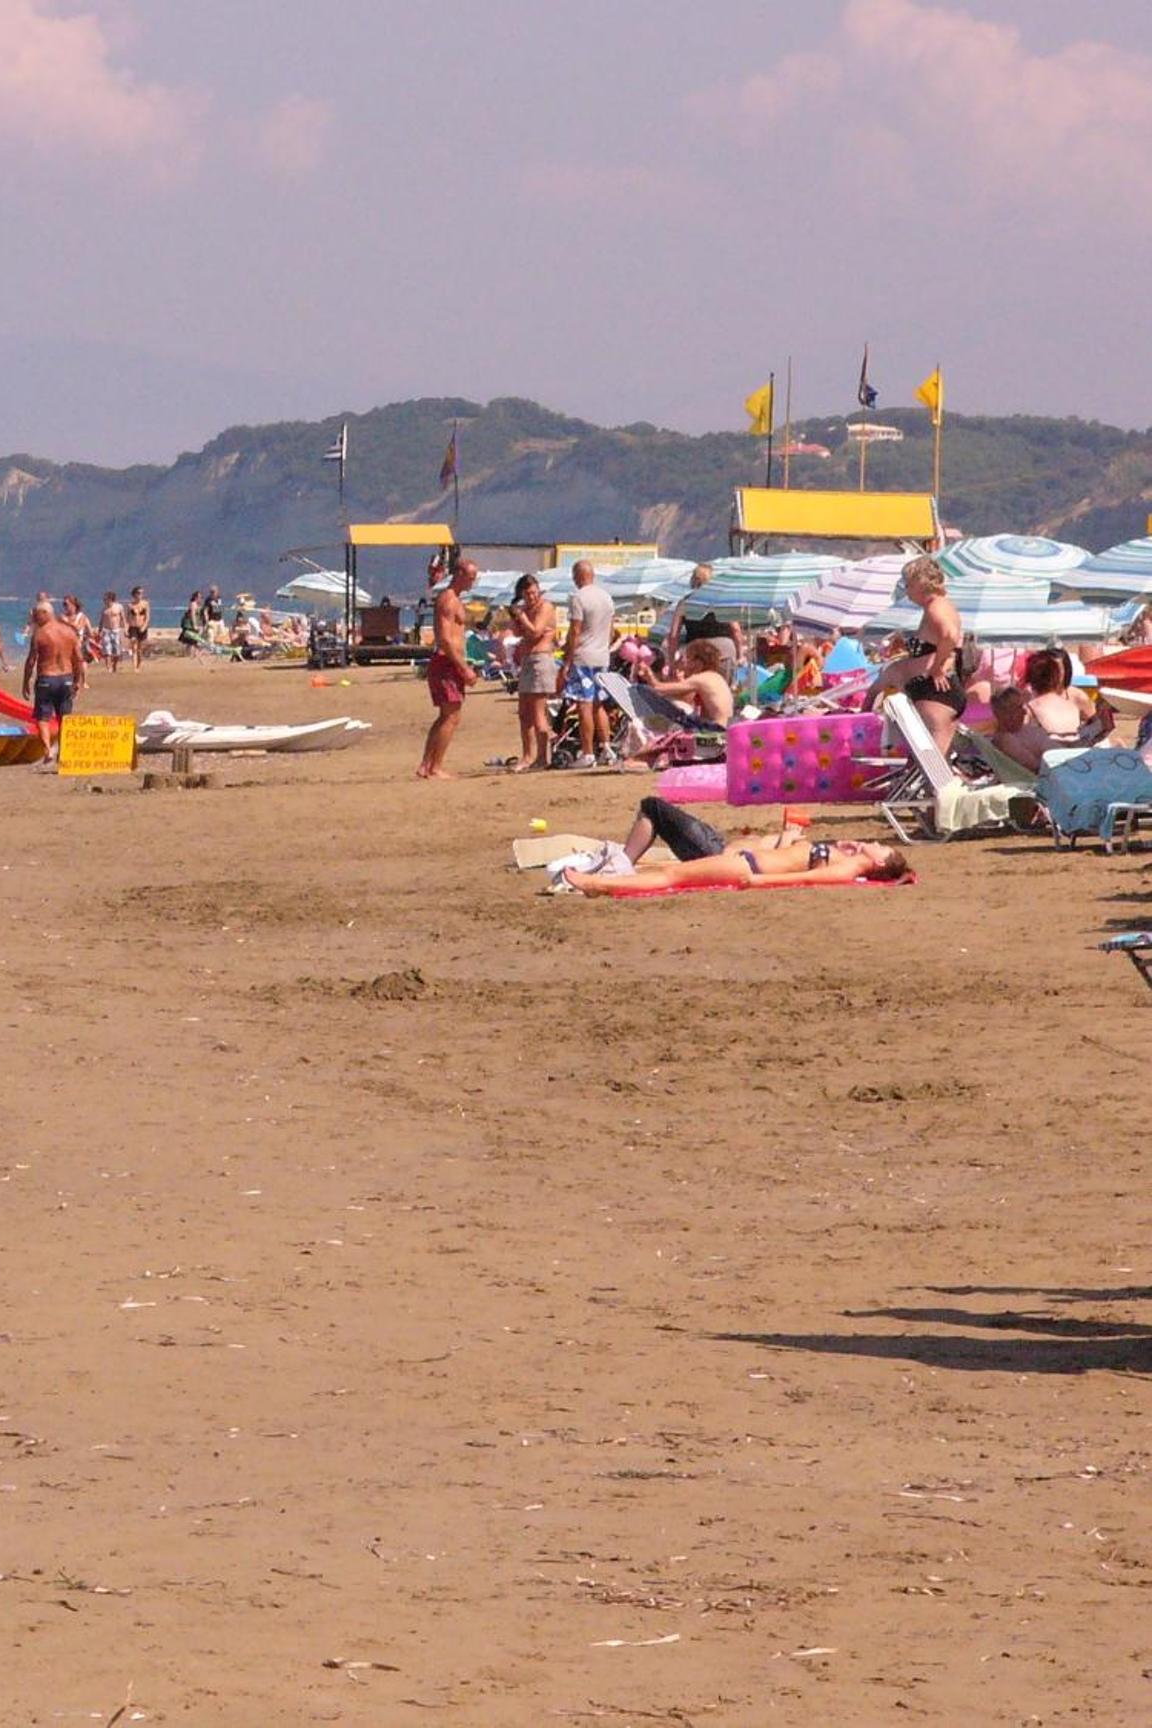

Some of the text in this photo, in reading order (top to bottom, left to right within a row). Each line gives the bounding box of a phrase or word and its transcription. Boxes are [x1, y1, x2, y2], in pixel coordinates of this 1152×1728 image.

[65, 716, 97, 726] PEDAL
[66, 729, 87, 740] PER
[90, 730, 119, 740] HOUR
